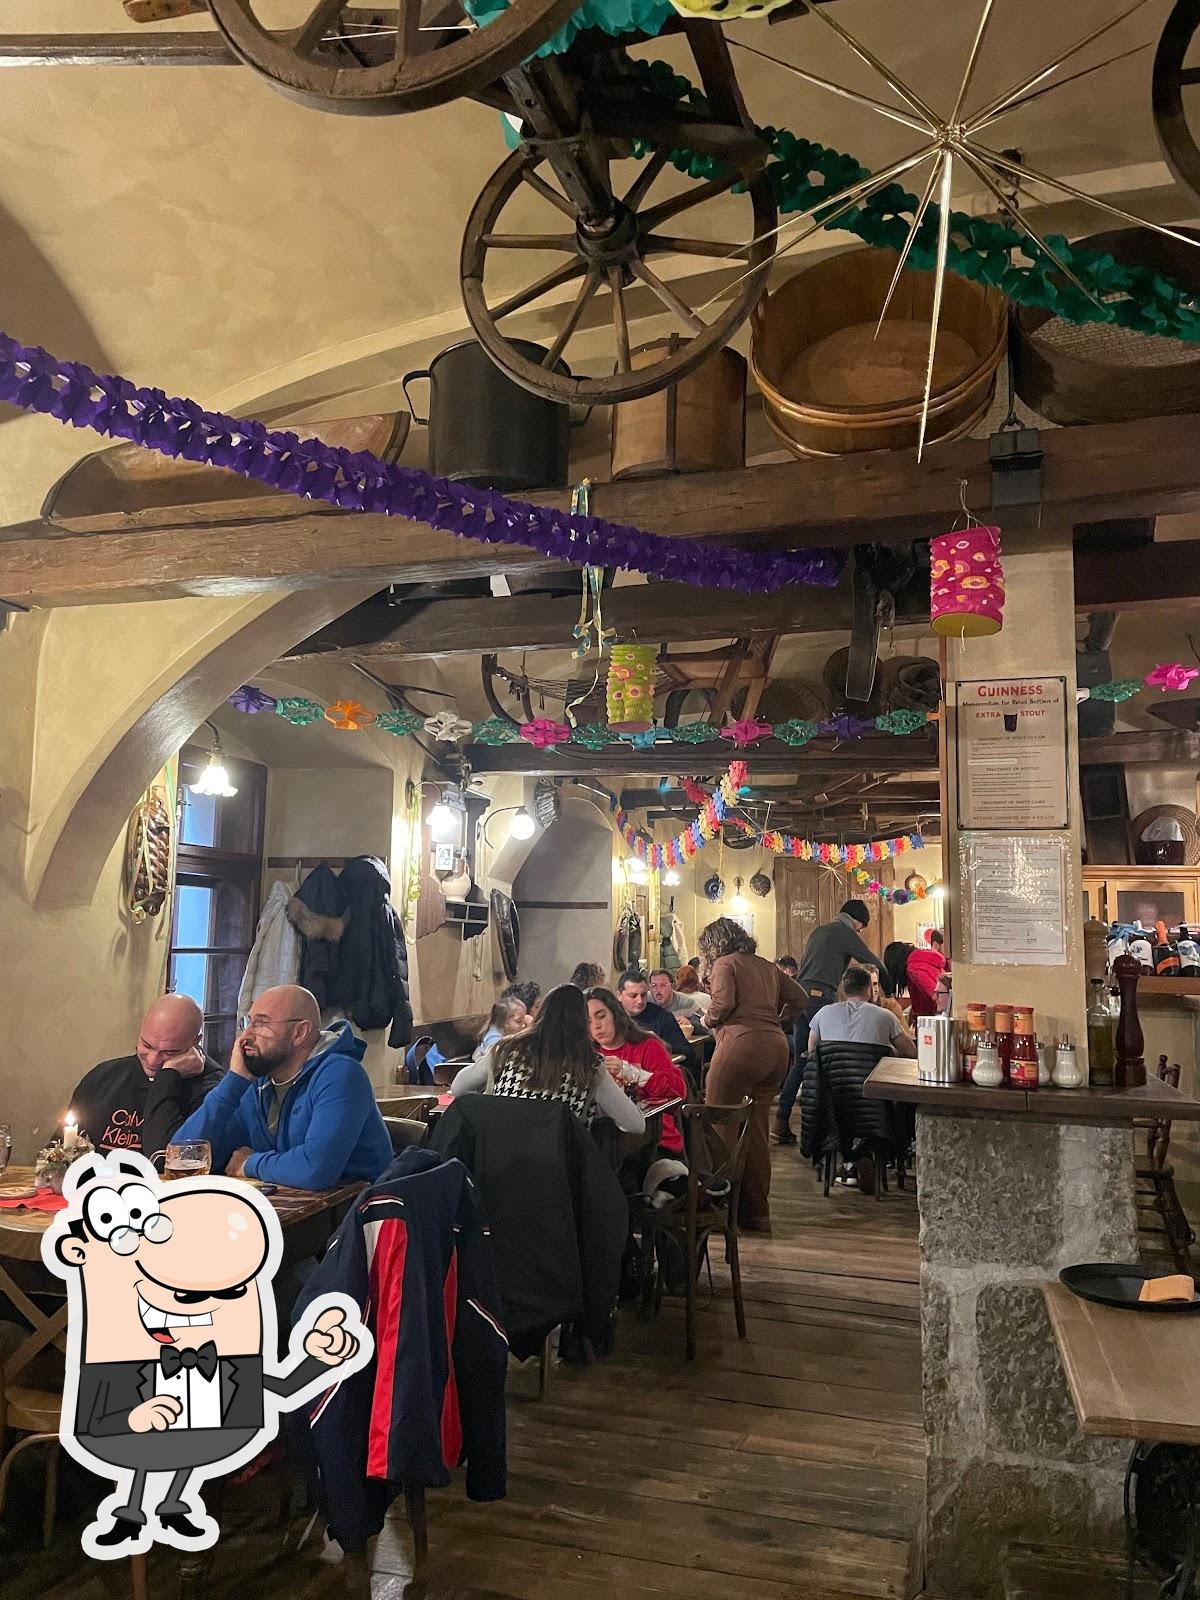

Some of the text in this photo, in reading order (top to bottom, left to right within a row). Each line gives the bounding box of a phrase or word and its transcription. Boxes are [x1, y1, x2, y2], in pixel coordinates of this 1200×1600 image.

[977, 685, 1043, 697] GUINNESS
[975, 709, 1046, 719] EXTRA STOUT
[102, 1125, 139, 1145] Klein
